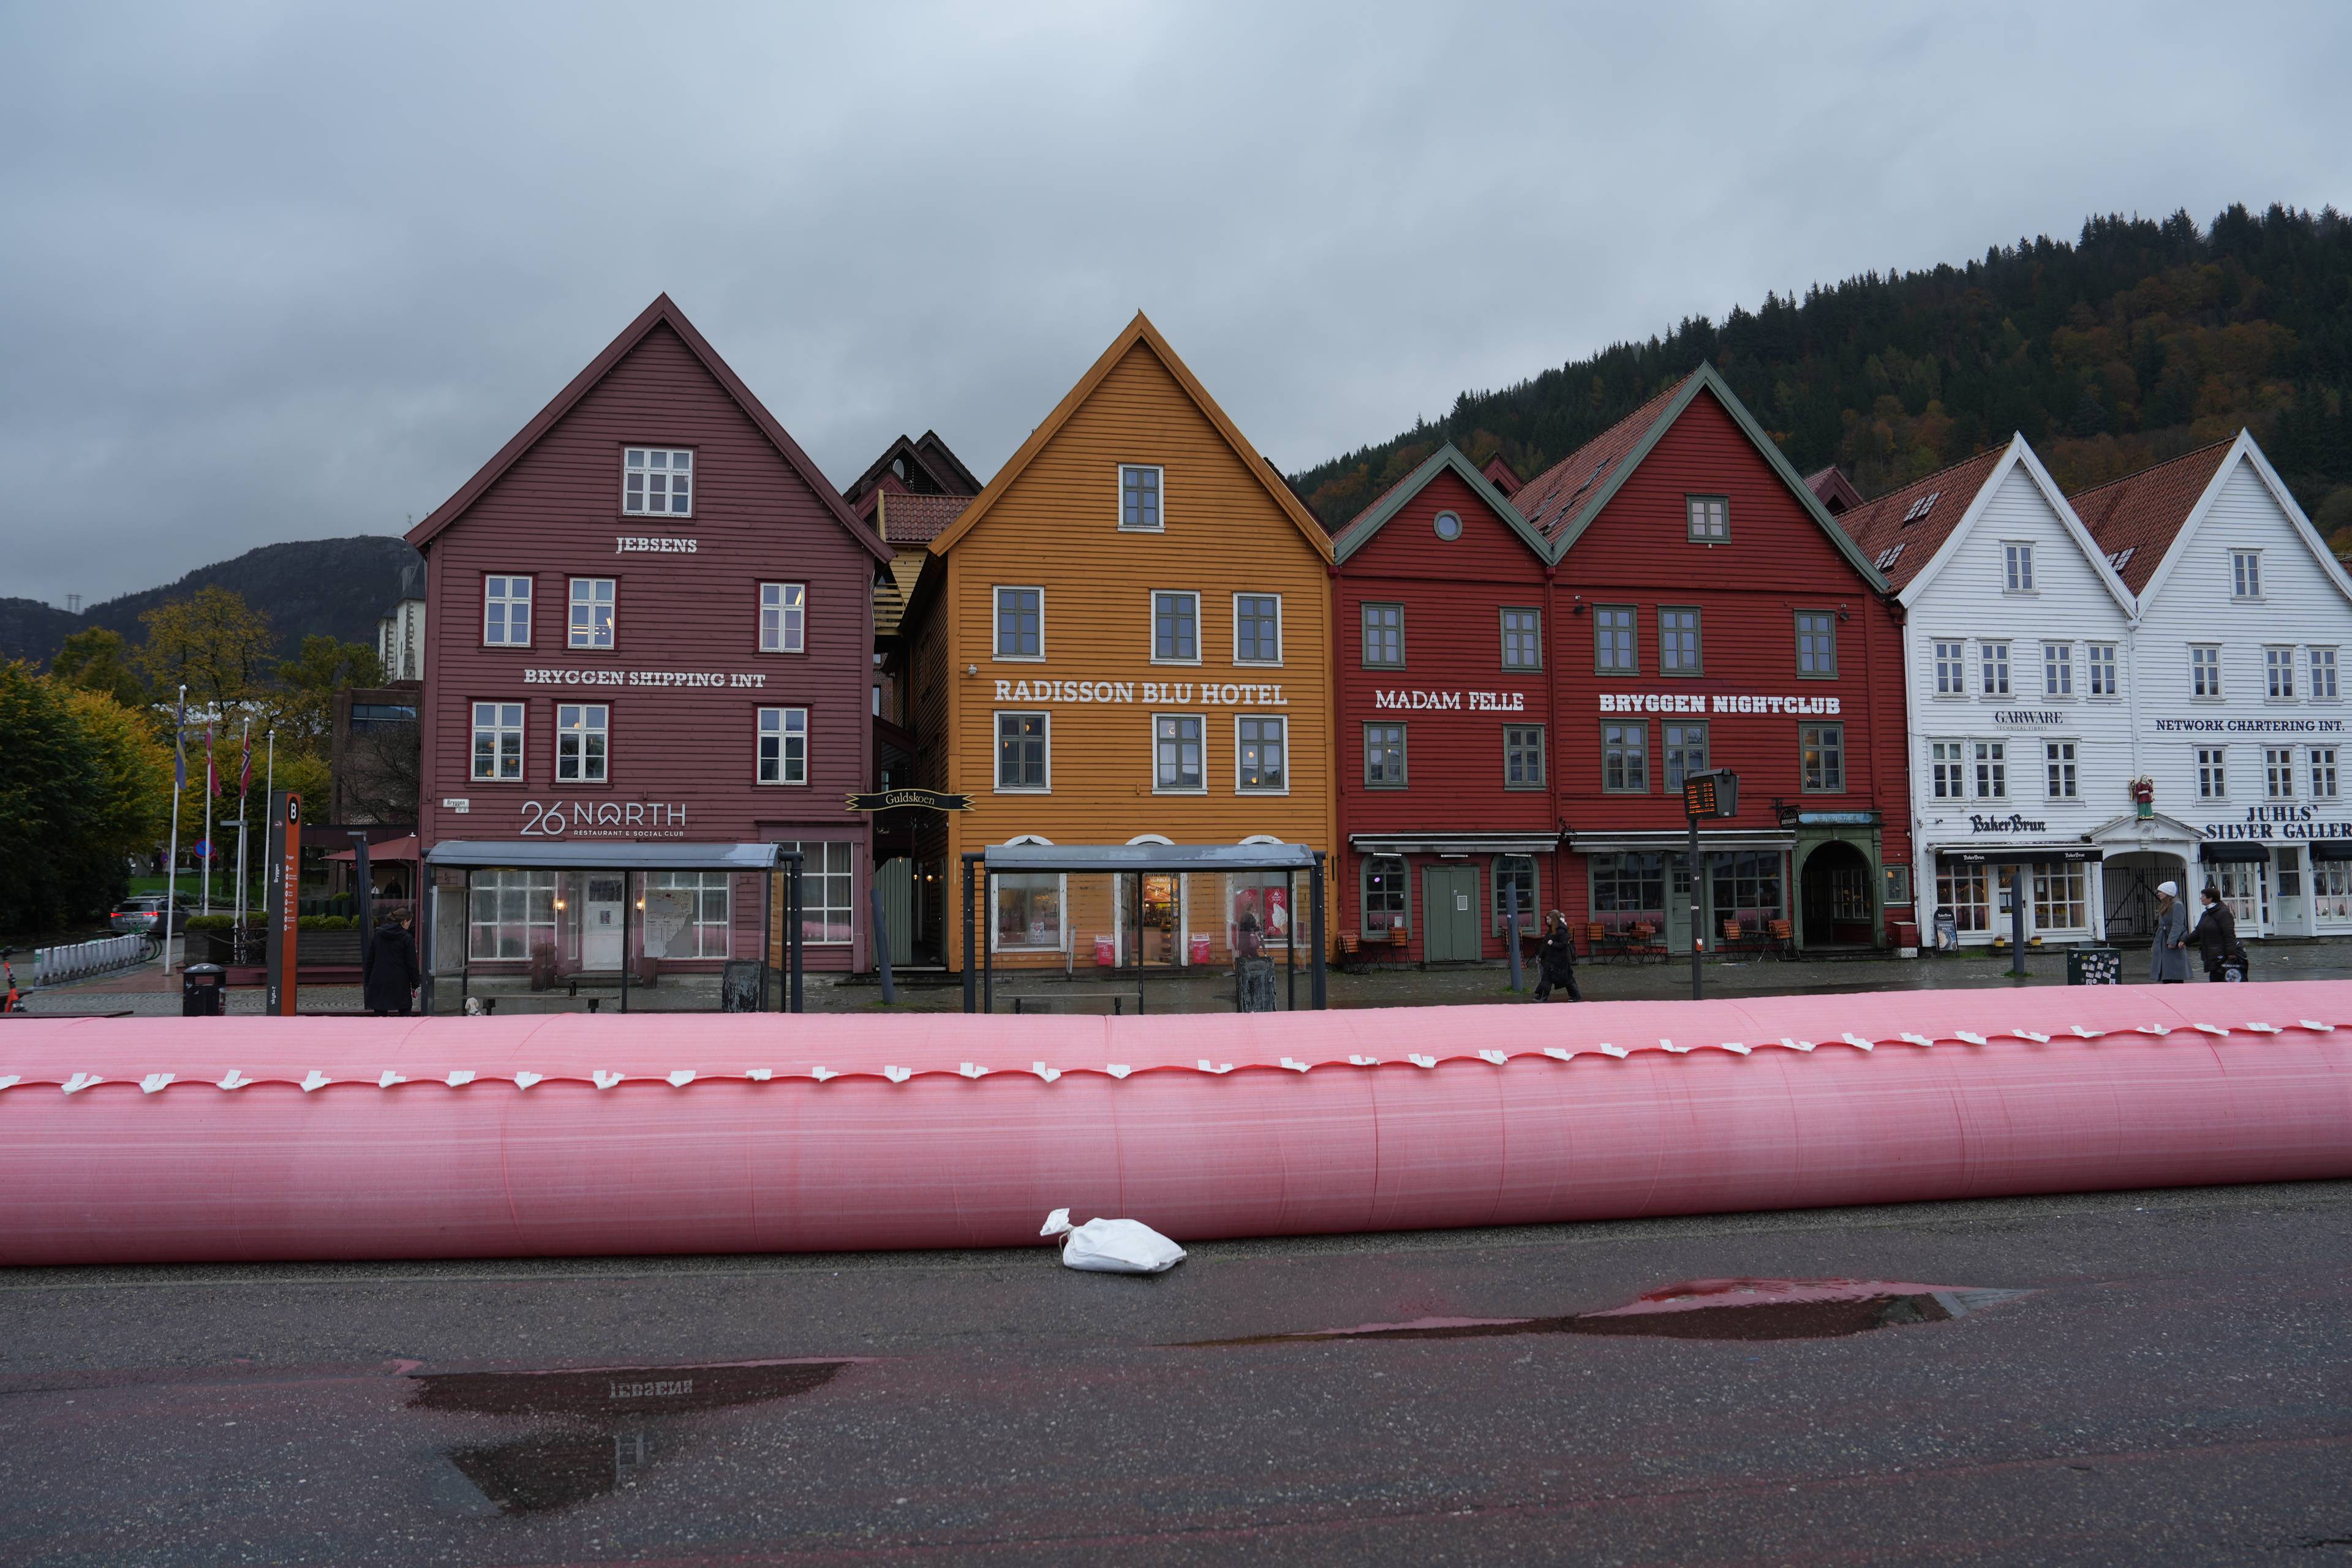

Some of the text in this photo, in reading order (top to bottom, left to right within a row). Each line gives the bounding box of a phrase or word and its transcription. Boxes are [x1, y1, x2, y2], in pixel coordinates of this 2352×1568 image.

[616, 537, 697, 554] JEBSENS
[524, 669, 766, 688] BRYGGEN SHIPPING INT
[994, 680, 1288, 705] RADISSON BLU HOTEL
[1375, 690, 1524, 711] MADAM FELLE
[1599, 694, 1840, 714] BRYGGEN NIGHTCLUB
[1995, 711, 2063, 723] GARWARE
[2155, 720, 2345, 731] NETWORK CHARTERING INT.
[886, 792, 935, 805] Guldskoen
[291, 803, 296, 819] B
[520, 801, 686, 835] 26 NORTH
[2206, 824, 2274, 839] SILVER
